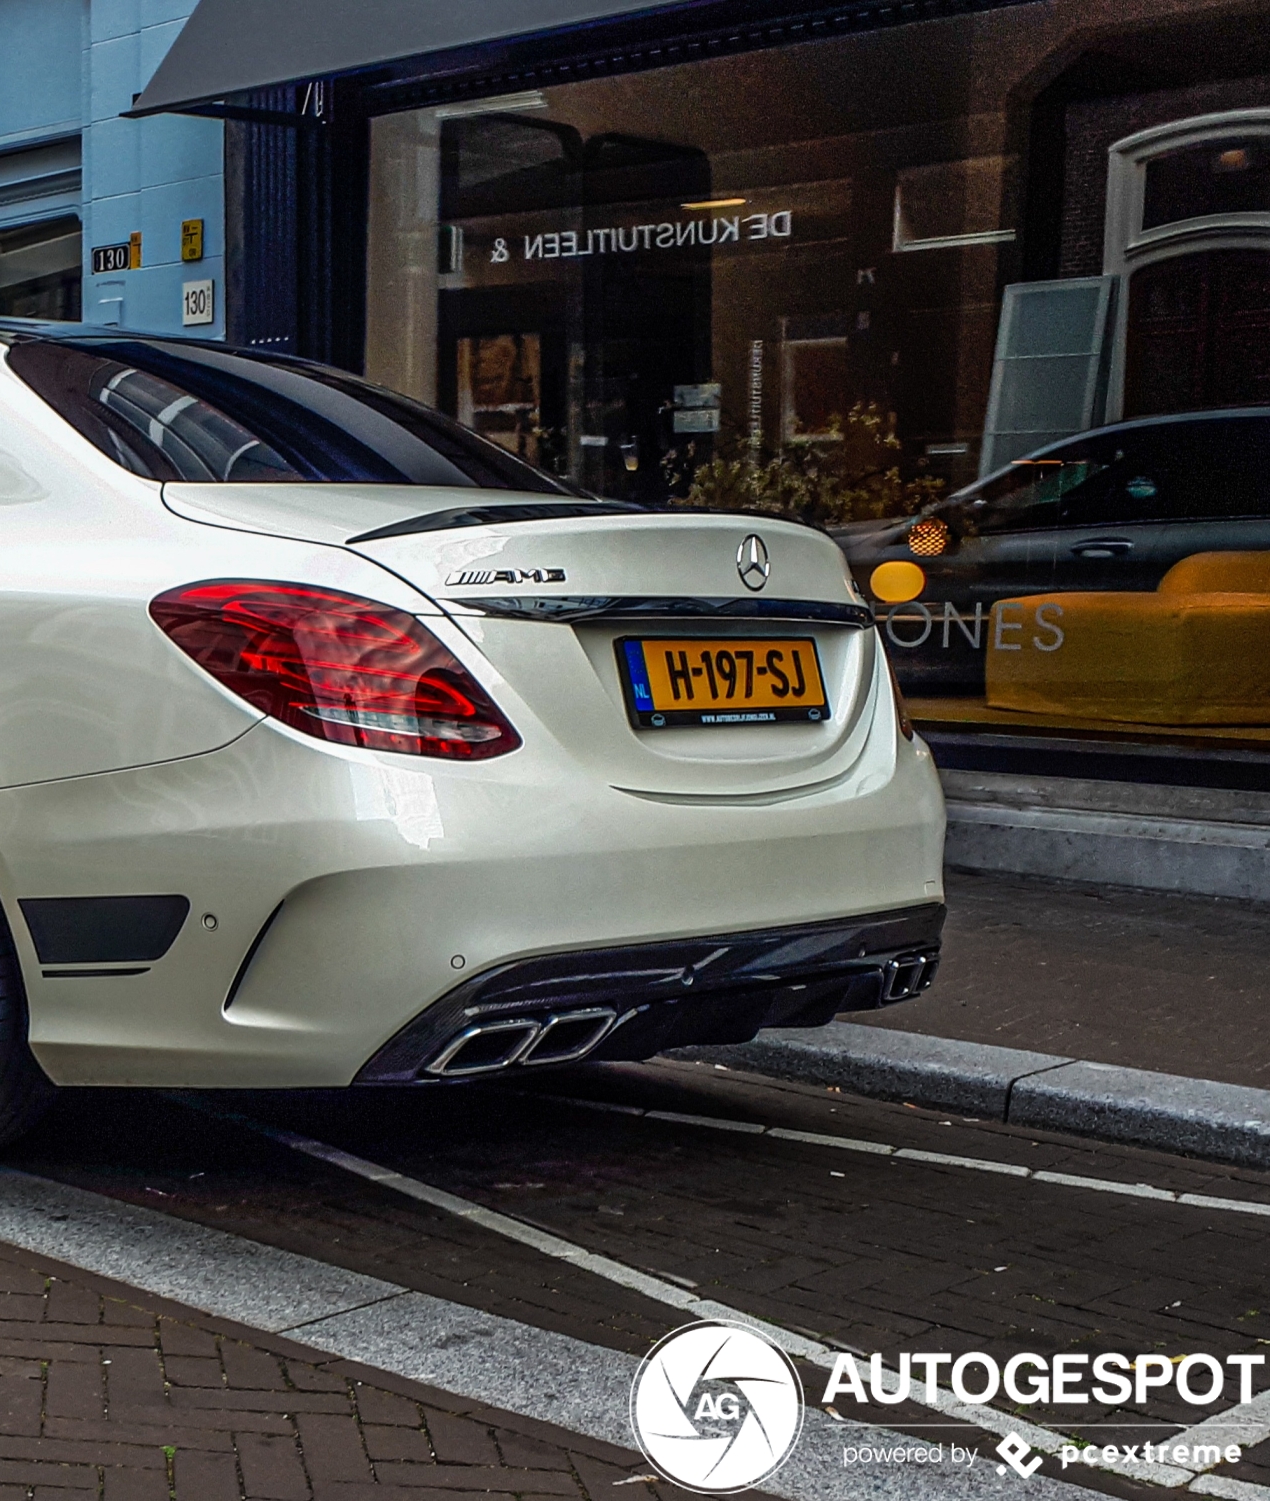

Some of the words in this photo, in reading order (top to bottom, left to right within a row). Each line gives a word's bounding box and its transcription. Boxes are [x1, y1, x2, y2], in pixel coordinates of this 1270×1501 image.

[98, 248, 126, 271] 130
[185, 289, 207, 316] 130
[870, 601, 1065, 652] ONES
[664, 649, 807, 700] H-197-SJ
[633, 683, 650, 699] NL
